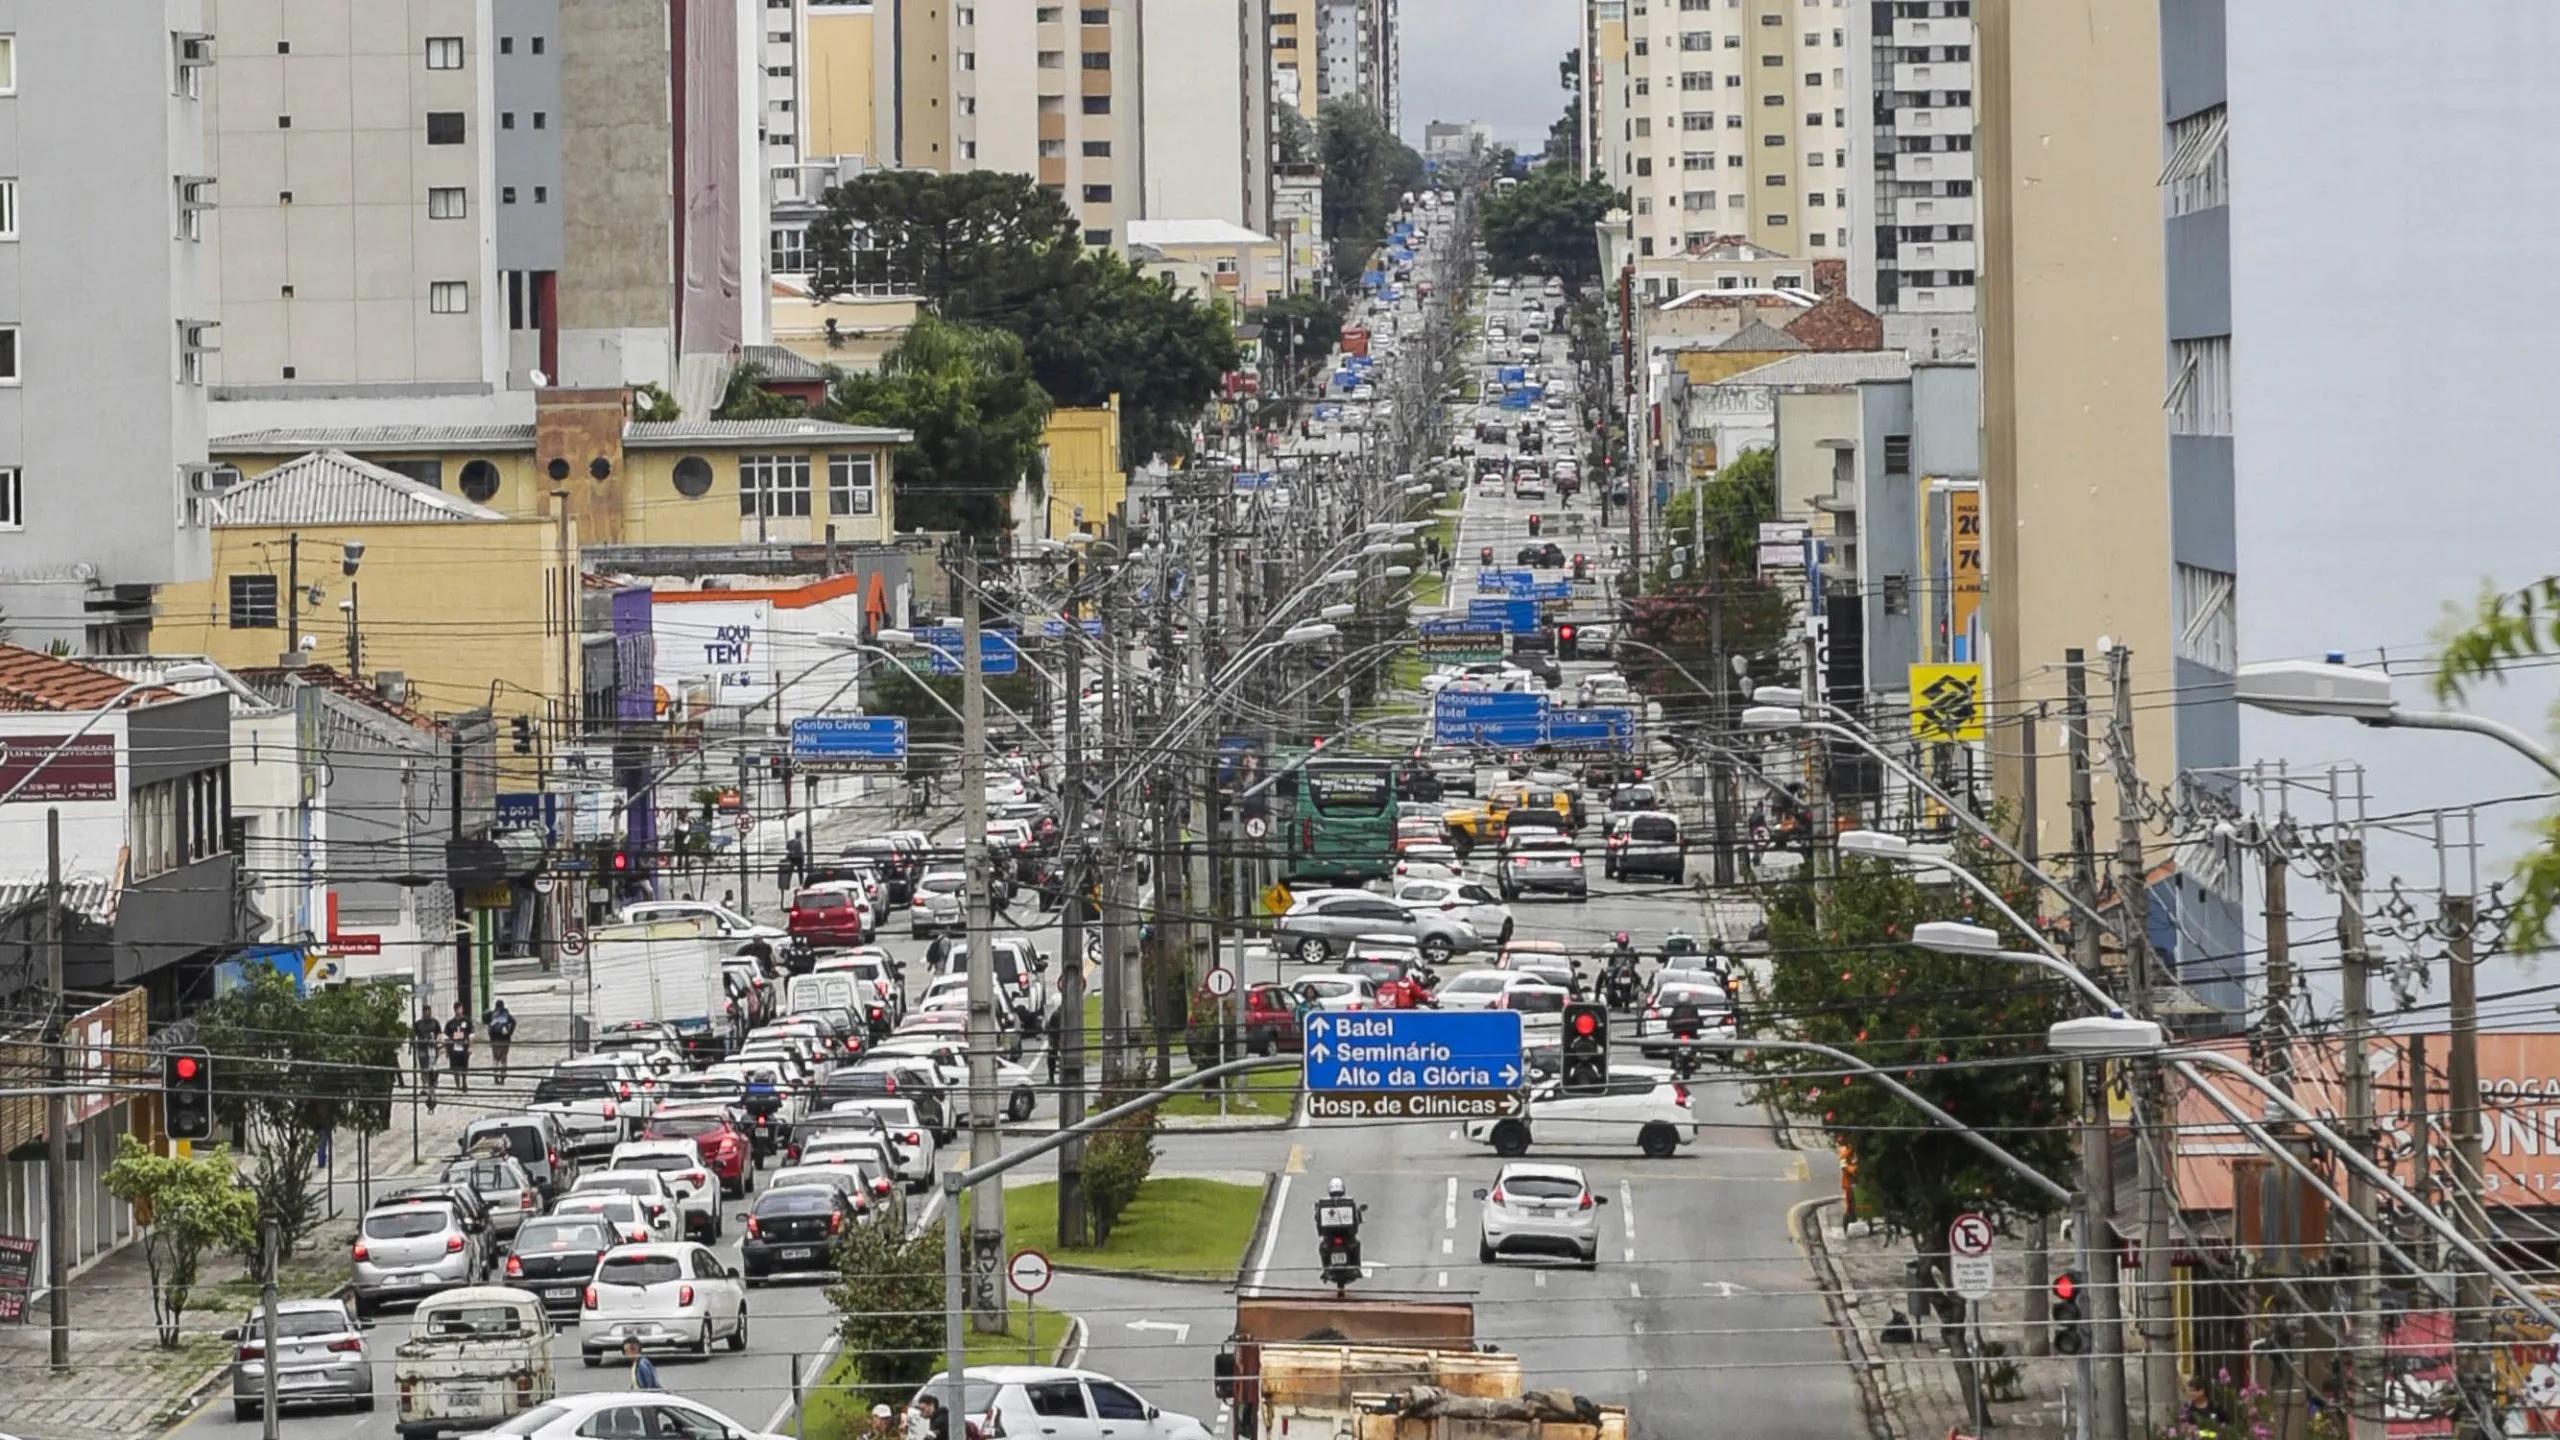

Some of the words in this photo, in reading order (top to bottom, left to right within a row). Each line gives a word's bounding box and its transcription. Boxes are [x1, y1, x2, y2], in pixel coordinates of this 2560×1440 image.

[716, 625, 750, 644] AQUI
[1436, 694, 1494, 706] Rebouças
[1436, 707, 1467, 717] Batel
[794, 719, 832, 730] Centro
[835, 719, 872, 730] Cívico
[1336, 1018, 1393, 1037] Batel
[1336, 1042, 1450, 1062] Seminário
[1336, 1067, 1380, 1086] Alto
[1388, 1067, 1415, 1086] da
[1423, 1066, 1490, 1086] Glória
[1408, 1096, 1496, 1115] Clínicas
